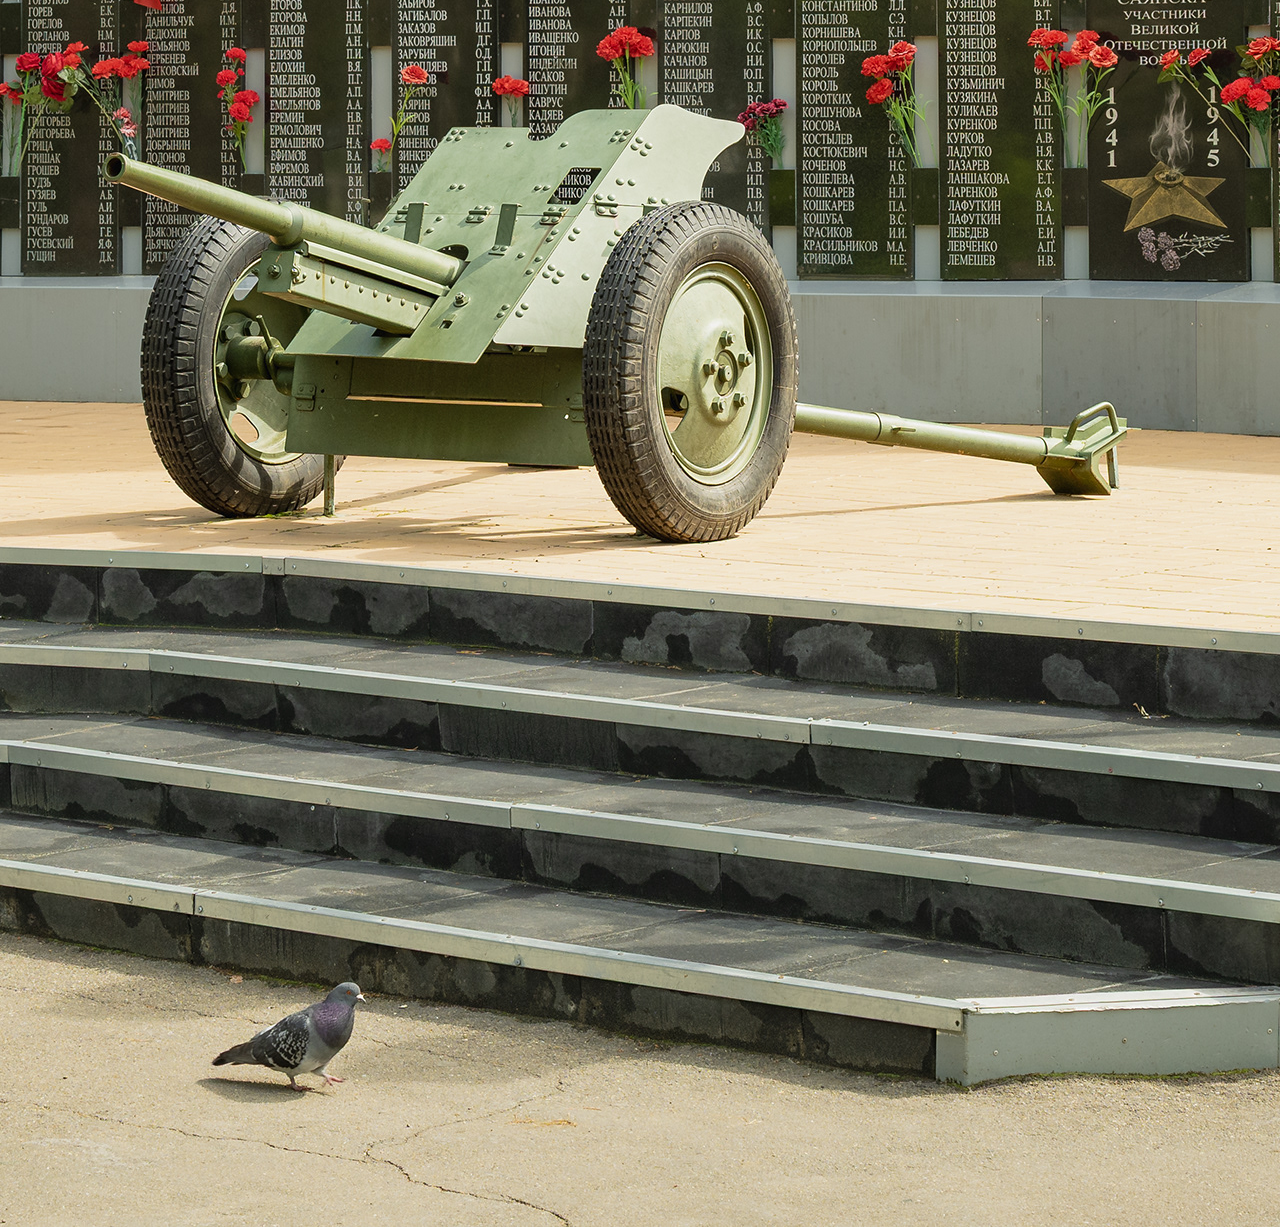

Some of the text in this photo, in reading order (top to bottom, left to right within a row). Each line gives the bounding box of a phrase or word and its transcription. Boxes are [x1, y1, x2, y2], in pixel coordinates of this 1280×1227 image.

[528, 6, 627, 17] ИВАНОВА А.Н.
[664, 2, 765, 15] КАРНИЛОВ А.Ф.
[1123, 9, 1206, 20] УЧАСТНИКИ
[269, 11, 364, 23] ЕГОРОВА Н.Н.
[801, 13, 907, 25] КОПЫЛОВ С.Э.
[664, 29, 765, 40] КАРПОВ И.К.
[1131, 22, 1199, 35] ВЕЛИКОЙ
[1104, 37, 1227, 50] ОТЕЧЕСТВЕННОЙ
[1139, 55, 1189, 66] ВОЫ
[663, 67, 765, 81] КАШИЦЫН Ю.П.
[663, 82, 765, 93] КАШКАРЕВ В.Л.
[145, 114, 191, 126] ДМИТРИЕВ
[269, 124, 364, 135] ЕРМОЛОВИЧ Н.Г.
[145, 138, 191, 152] ДОБРЫНИН
[269, 137, 363, 149] ЕРМАШЕНКО Н.А.
[802, 146, 907, 158] КОСТЮКЕВИЧ Н.А.
[946, 173, 1055, 184] ЛАНШАКОВА Е.Т.
[947, 200, 1055, 212] ЛАФУТКИН В.А.
[26, 236, 115, 249] ГУСЕВСКИЙ Я.Ф.
[803, 240, 907, 252] КРАСИЛЬНИКОВ М.А.
[26, 251, 115, 263] ГУЩИН Д.К.
[803, 253, 908, 266] КРИВЦОВА Н.Е.
[946, 253, 1057, 266] ЛЕМЕШЕВ Н.В.
